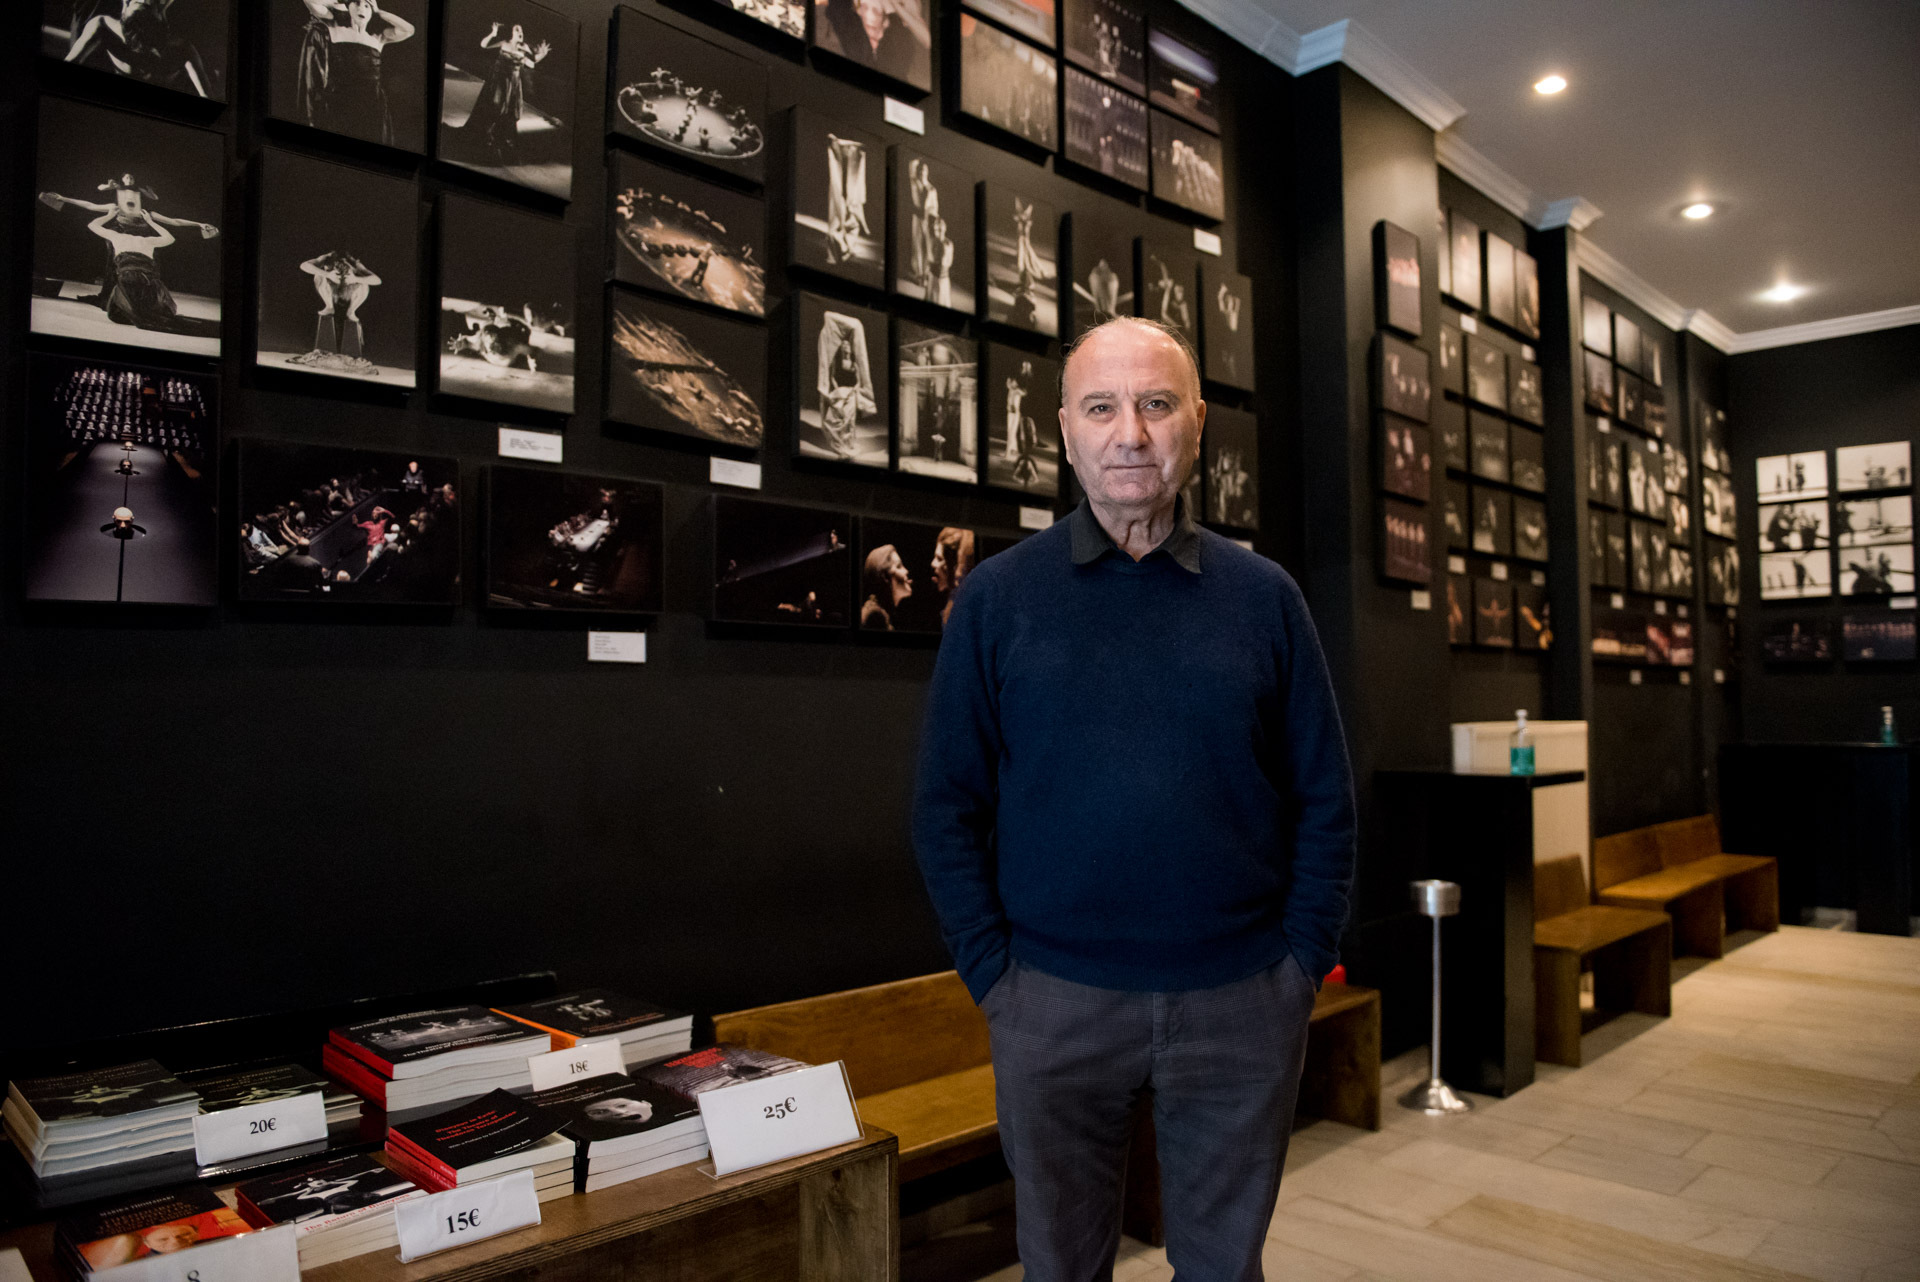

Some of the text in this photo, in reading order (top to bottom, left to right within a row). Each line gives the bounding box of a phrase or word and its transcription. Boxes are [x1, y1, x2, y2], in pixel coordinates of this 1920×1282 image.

[569, 1061, 589, 1074] 18€
[763, 1096, 798, 1119] 25€
[249, 1117, 277, 1135] 20€
[304, 1223, 323, 1232] The
[324, 1211, 356, 1225] Return
[357, 1205, 367, 1213] of
[446, 1208, 481, 1234] 15€
